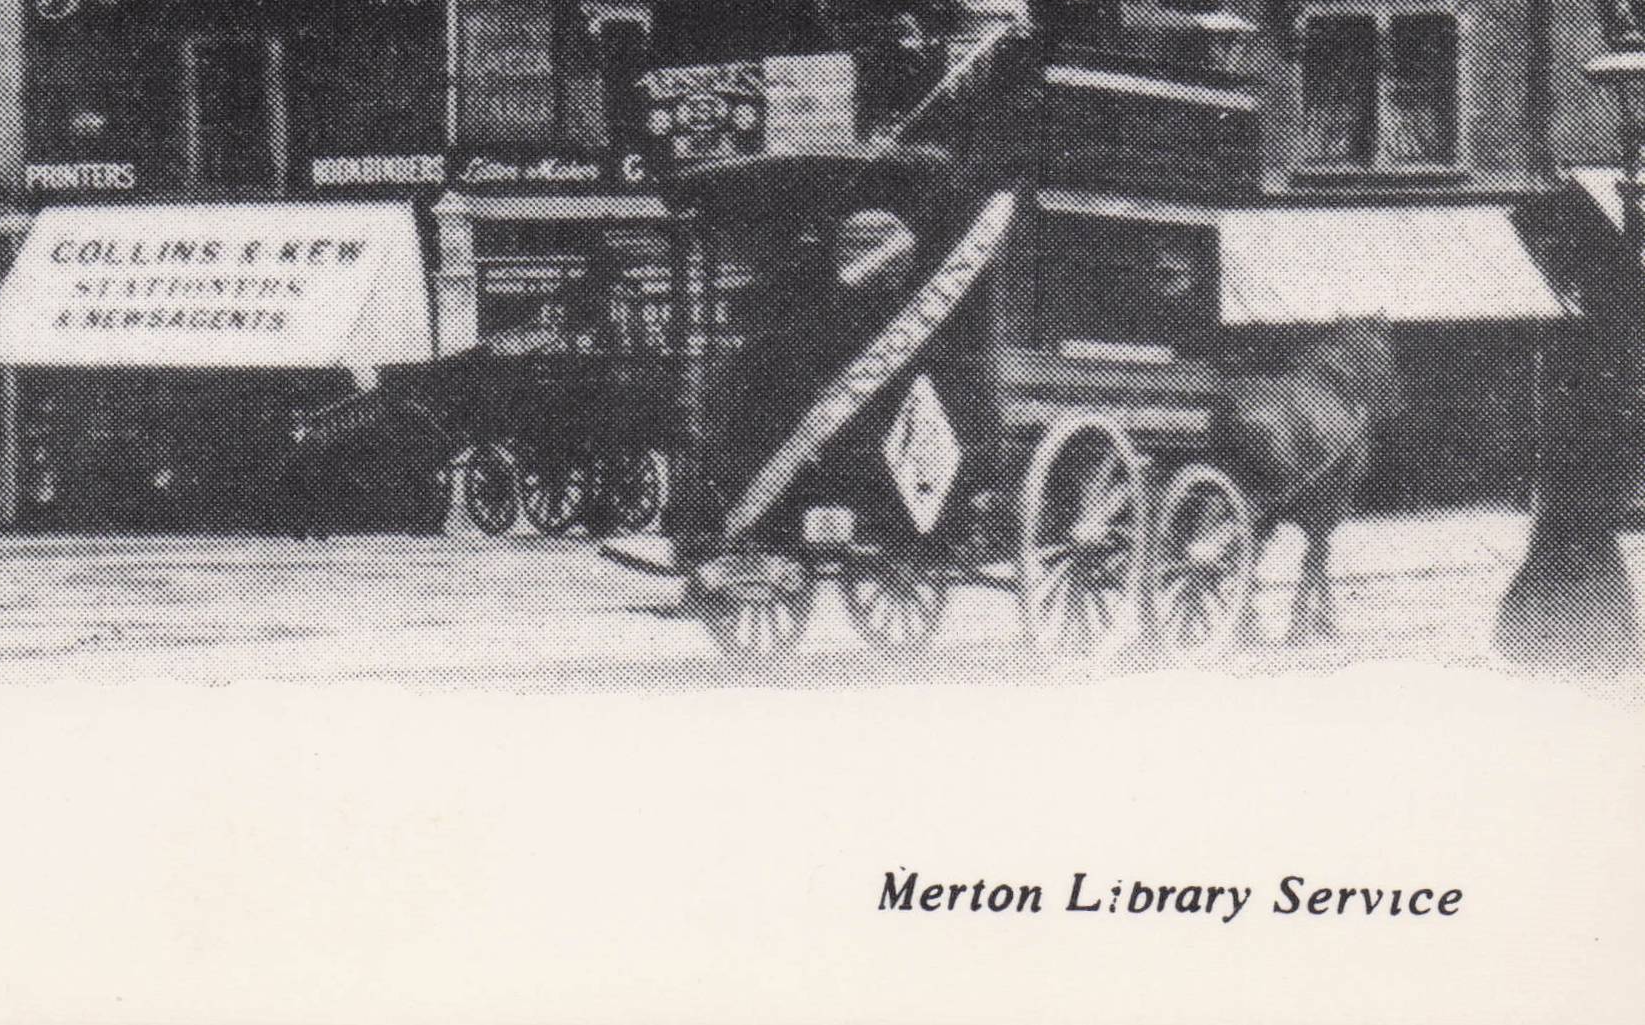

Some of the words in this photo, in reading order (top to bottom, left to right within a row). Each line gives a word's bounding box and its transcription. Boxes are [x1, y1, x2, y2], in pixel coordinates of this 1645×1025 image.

[25, 162, 137, 191] PRINTERS
[50, 239, 223, 266] COLLINS
[239, 240, 263, 267] &
[278, 238, 368, 266] KEW
[73, 275, 309, 299] STATIONERS
[82, 307, 290, 332] NEWSAGENTS
